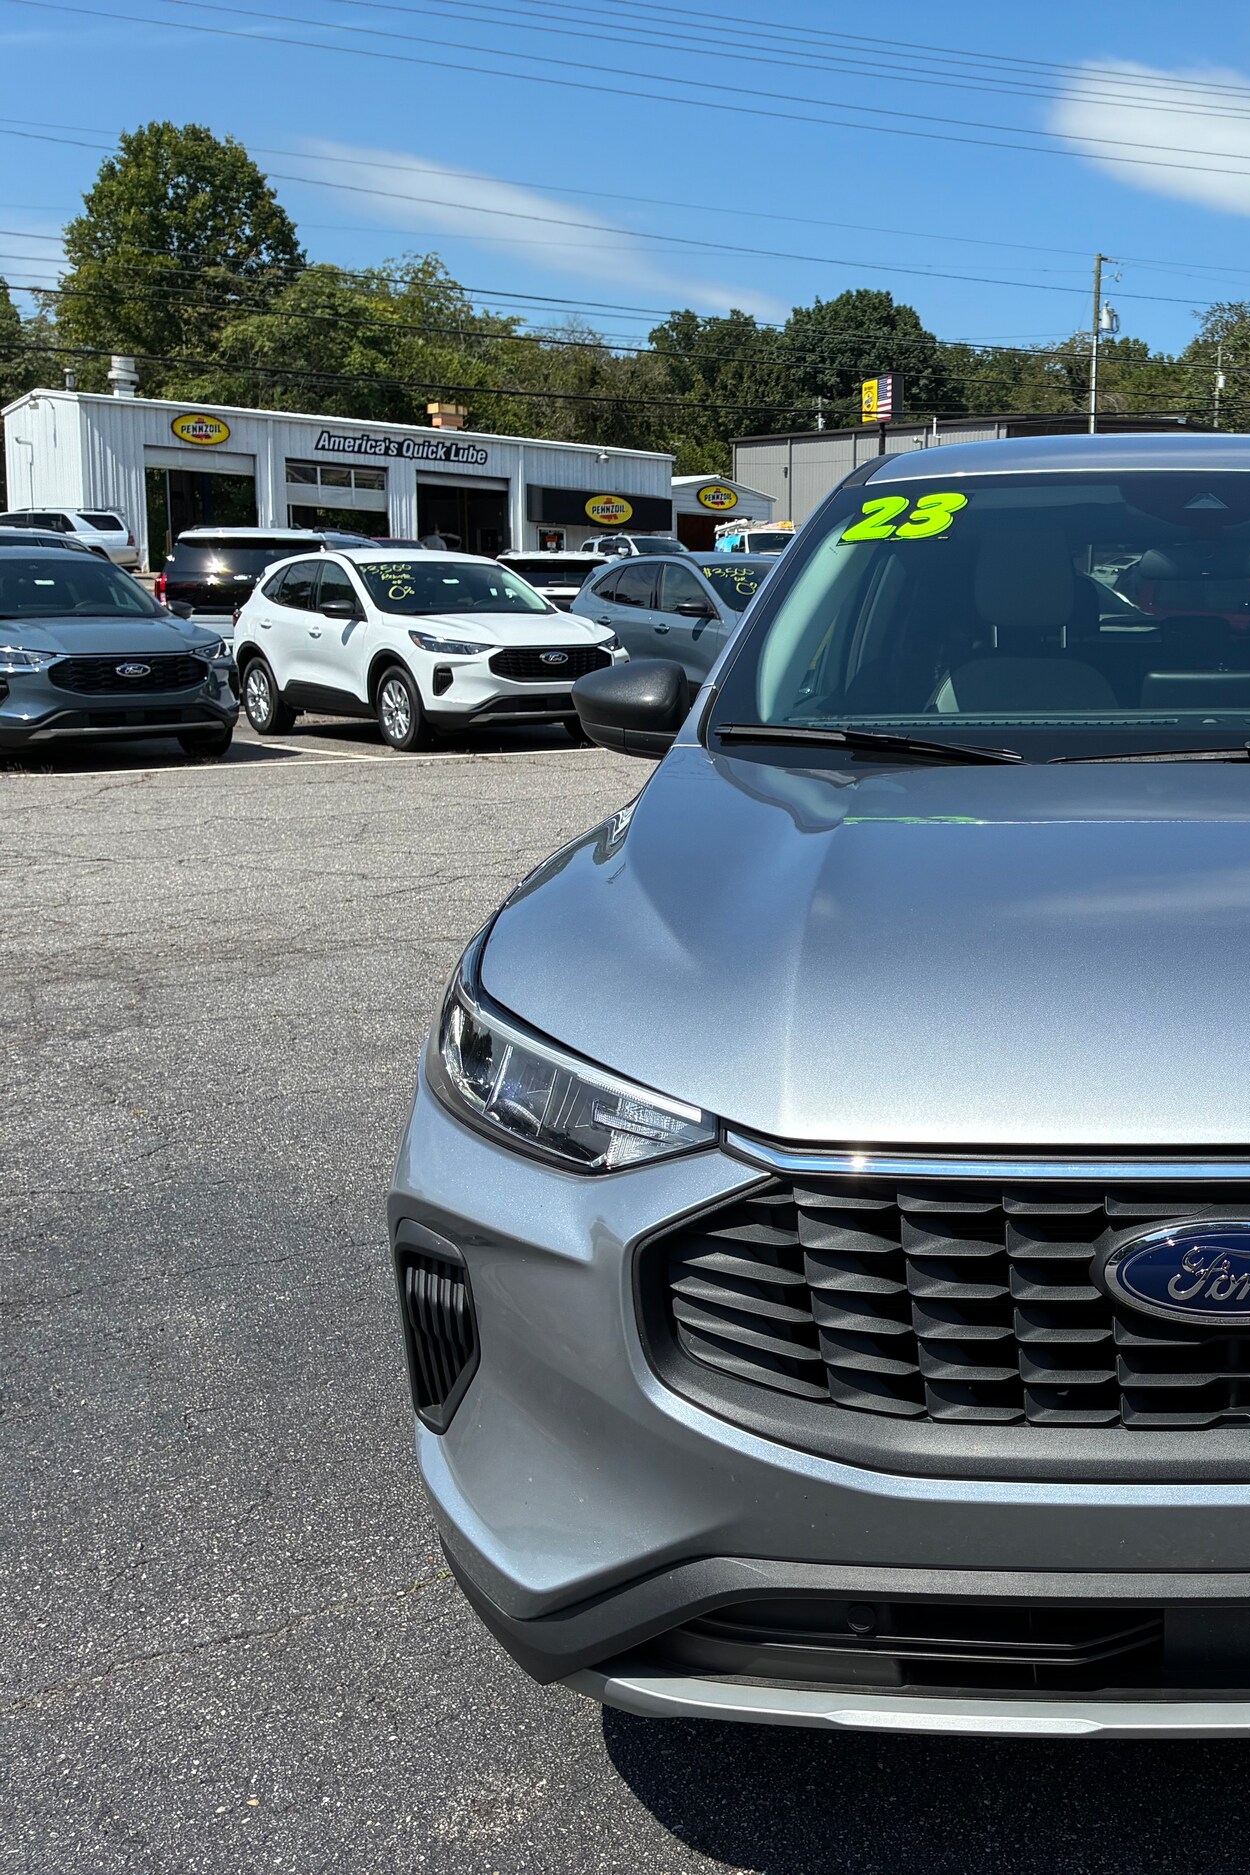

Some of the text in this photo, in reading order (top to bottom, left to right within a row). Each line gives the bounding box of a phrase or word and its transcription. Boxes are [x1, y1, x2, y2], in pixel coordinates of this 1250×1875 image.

[180, 424, 222, 434] PENNZOIL
[317, 432, 487, 464] America's Quick Lube
[703, 492, 733, 502] PENNZOIL
[591, 504, 626, 515] PENNZOIL
[841, 492, 969, 542] 23
